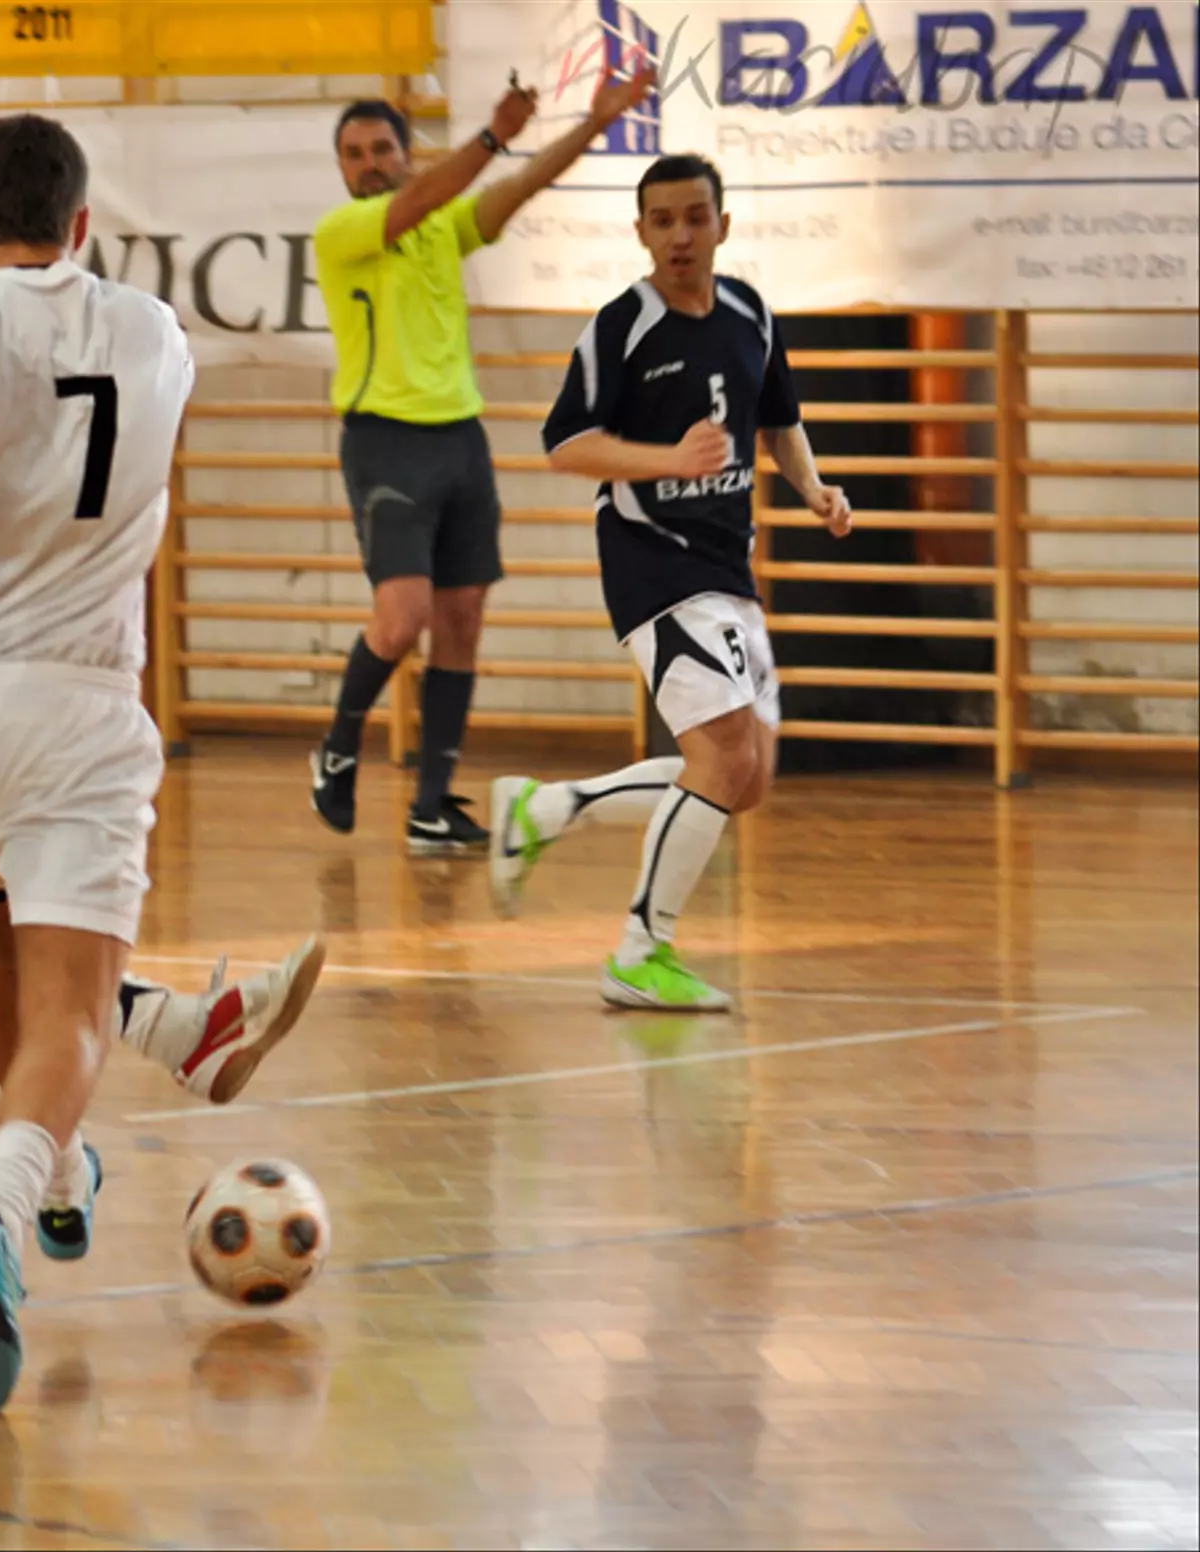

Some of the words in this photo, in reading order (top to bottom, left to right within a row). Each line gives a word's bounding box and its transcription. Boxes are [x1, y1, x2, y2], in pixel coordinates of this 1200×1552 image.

[13, 5, 73, 41] 2011
[718, 3, 1197, 109] BARZA
[708, 373, 728, 426] 5
[54, 373, 119, 520] 7
[723, 627, 746, 676] 5
